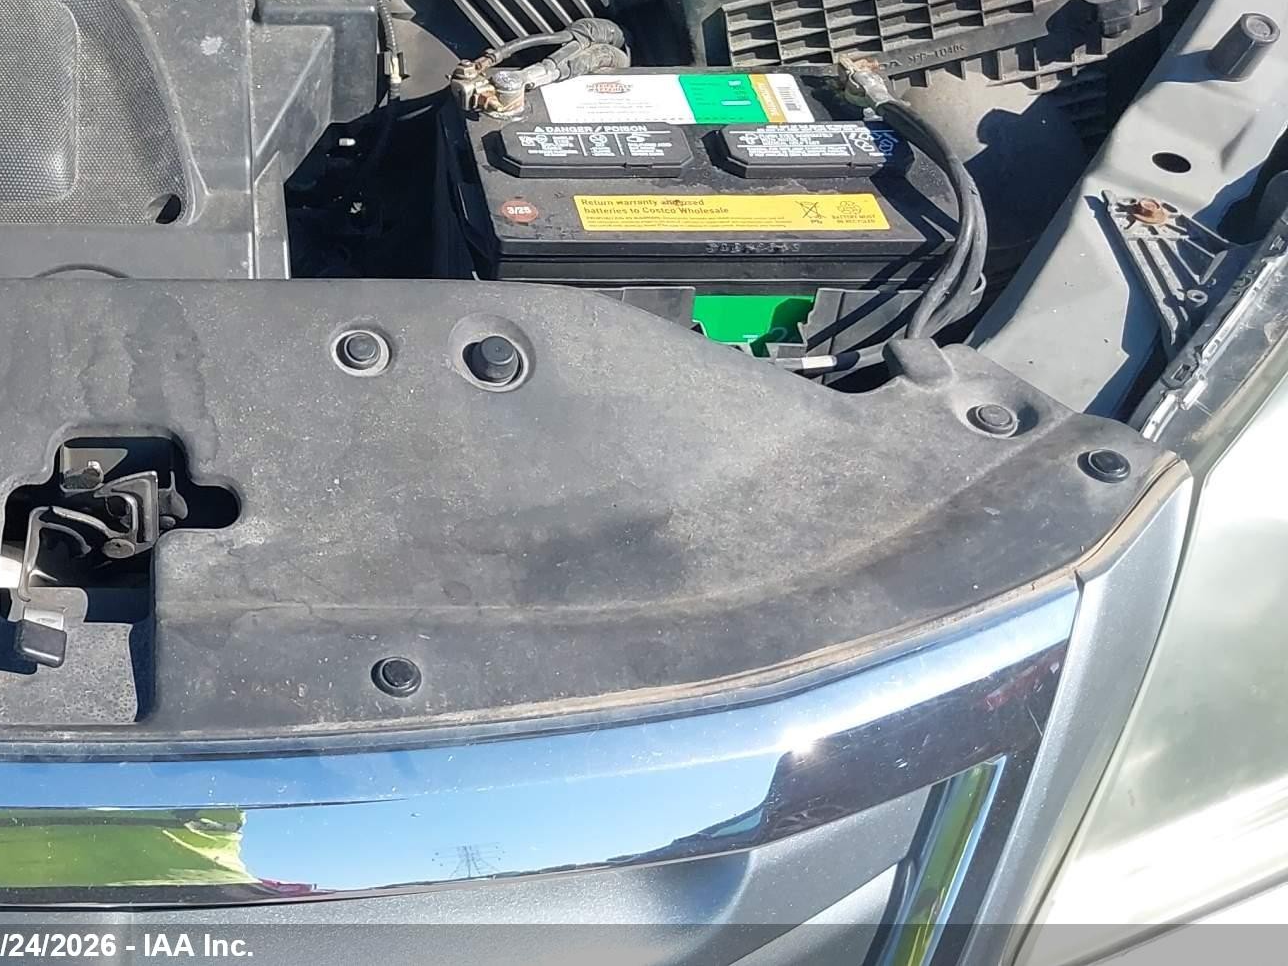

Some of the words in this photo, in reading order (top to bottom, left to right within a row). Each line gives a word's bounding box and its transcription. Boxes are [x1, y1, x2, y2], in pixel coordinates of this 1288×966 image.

[544, 126, 594, 134] DANGER
[604, 125, 648, 133] POISON
[581, 198, 613, 206] Return
[616, 199, 657, 207] warranty
[584, 206, 628, 214] batteries
[642, 206, 677, 214] Costco
[679, 206, 729, 214] Wholesale
